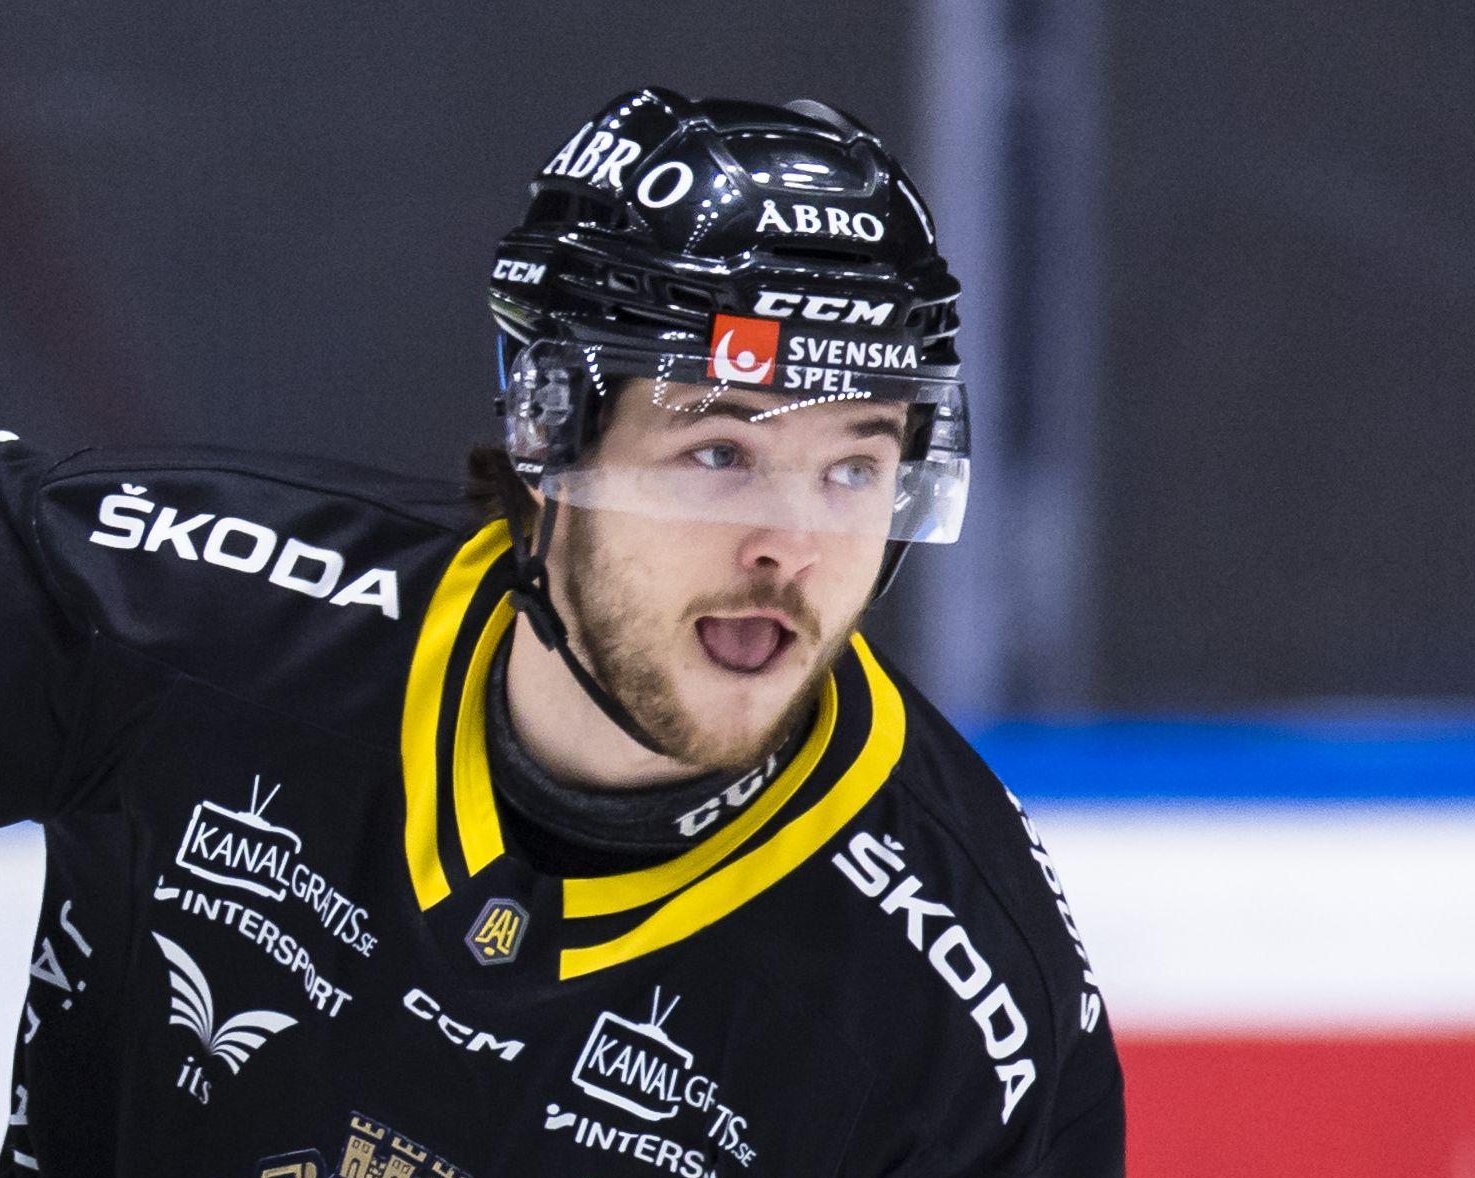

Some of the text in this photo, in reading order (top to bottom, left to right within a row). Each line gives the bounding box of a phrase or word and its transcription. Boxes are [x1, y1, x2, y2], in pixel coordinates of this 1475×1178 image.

[756, 200, 885, 242] ÅBRO
[492, 259, 546, 285] CCM
[753, 291, 895, 326] CCM
[788, 336, 919, 370] SVENSKA
[784, 366, 858, 394] SPEL
[89, 484, 400, 620] ŠKODA
[181, 889, 353, 1018] INTERSPORT
[831, 831, 1037, 1125] ŠKODA
[403, 989, 525, 1061] CCM
